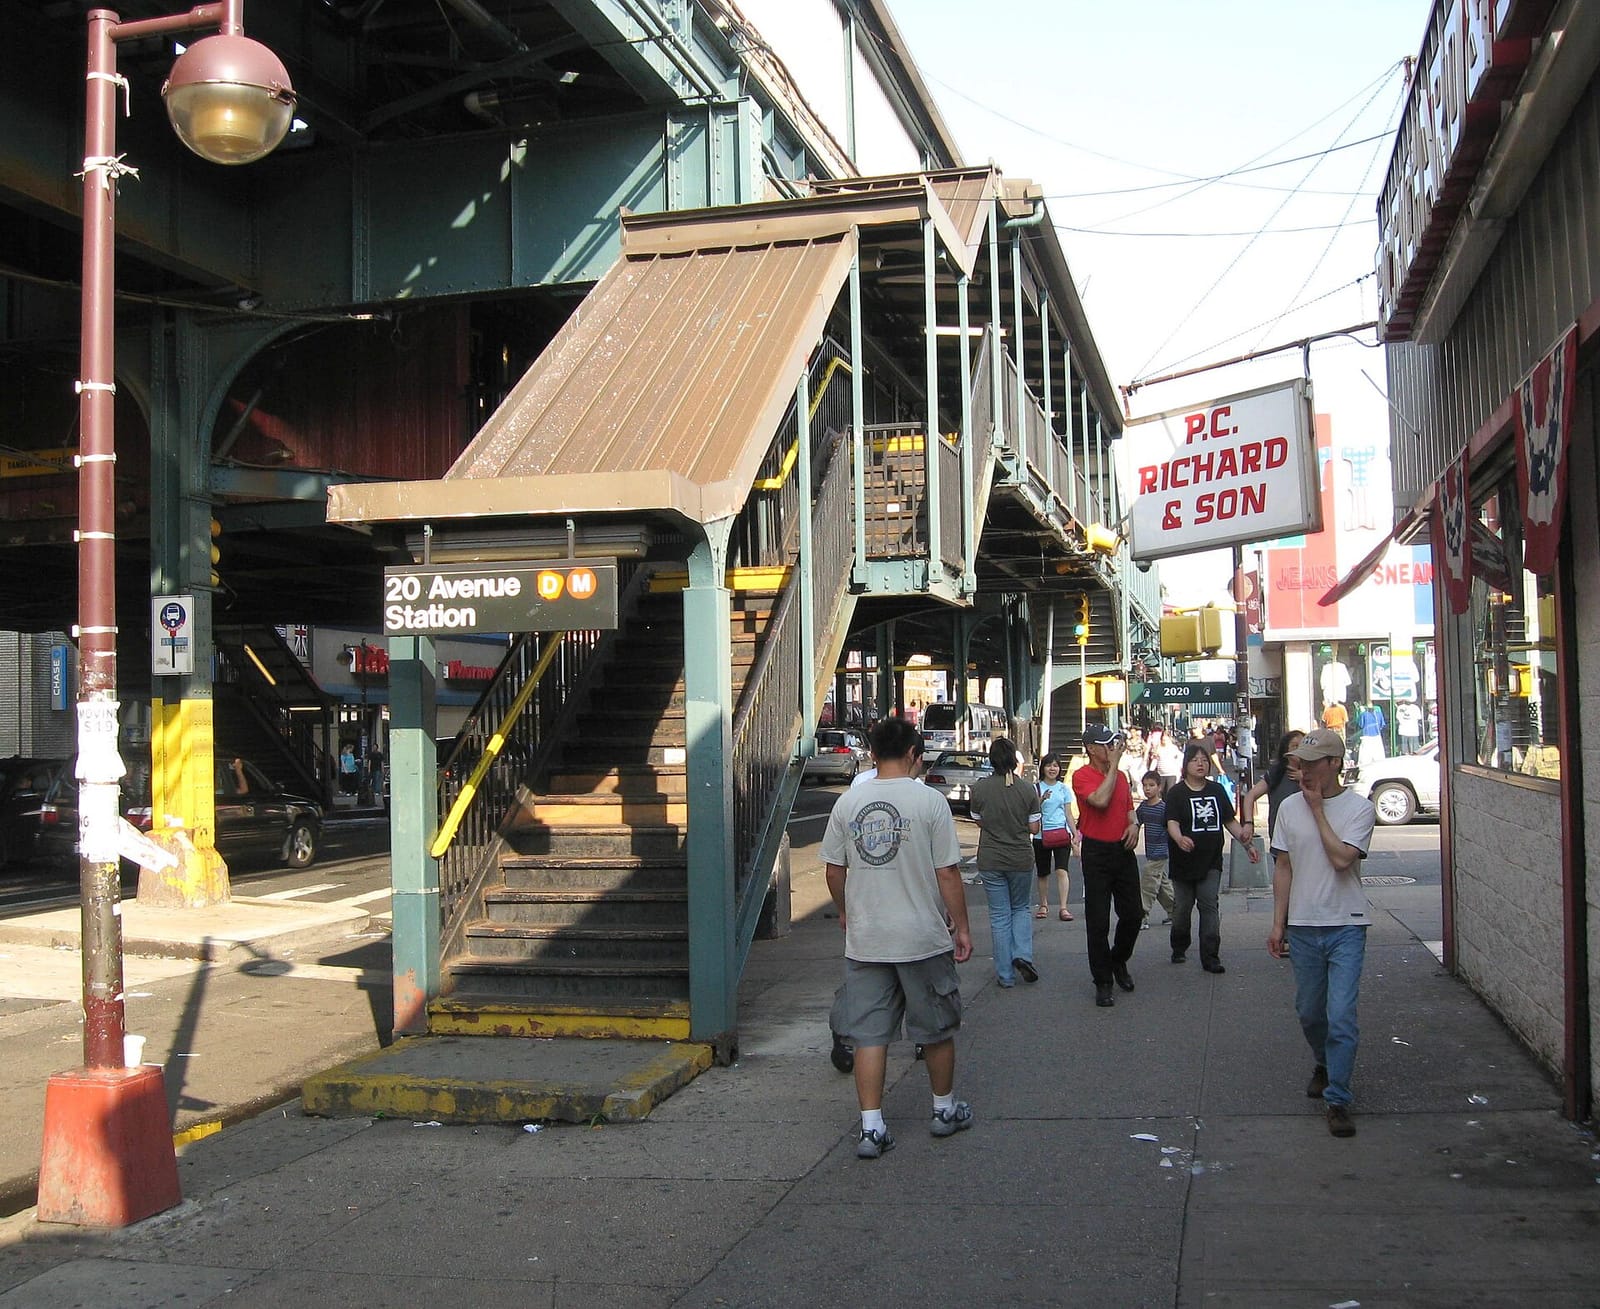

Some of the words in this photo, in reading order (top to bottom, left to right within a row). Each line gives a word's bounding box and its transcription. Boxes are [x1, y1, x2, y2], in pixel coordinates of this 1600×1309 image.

[1185, 406, 1238, 444] P.C.
[1138, 437, 1288, 495] RICHARD
[1162, 500, 1182, 530] &
[1194, 483, 1267, 525] SON
[386, 576, 421, 601] 20
[428, 575, 521, 600] Avenue
[543, 576, 558, 593] D
[571, 574, 591, 592] M
[1277, 564, 1338, 590] JEANS
[385, 604, 476, 630] Station
[53, 659, 61, 696] CHASE
[1163, 686, 1190, 696] 2020
